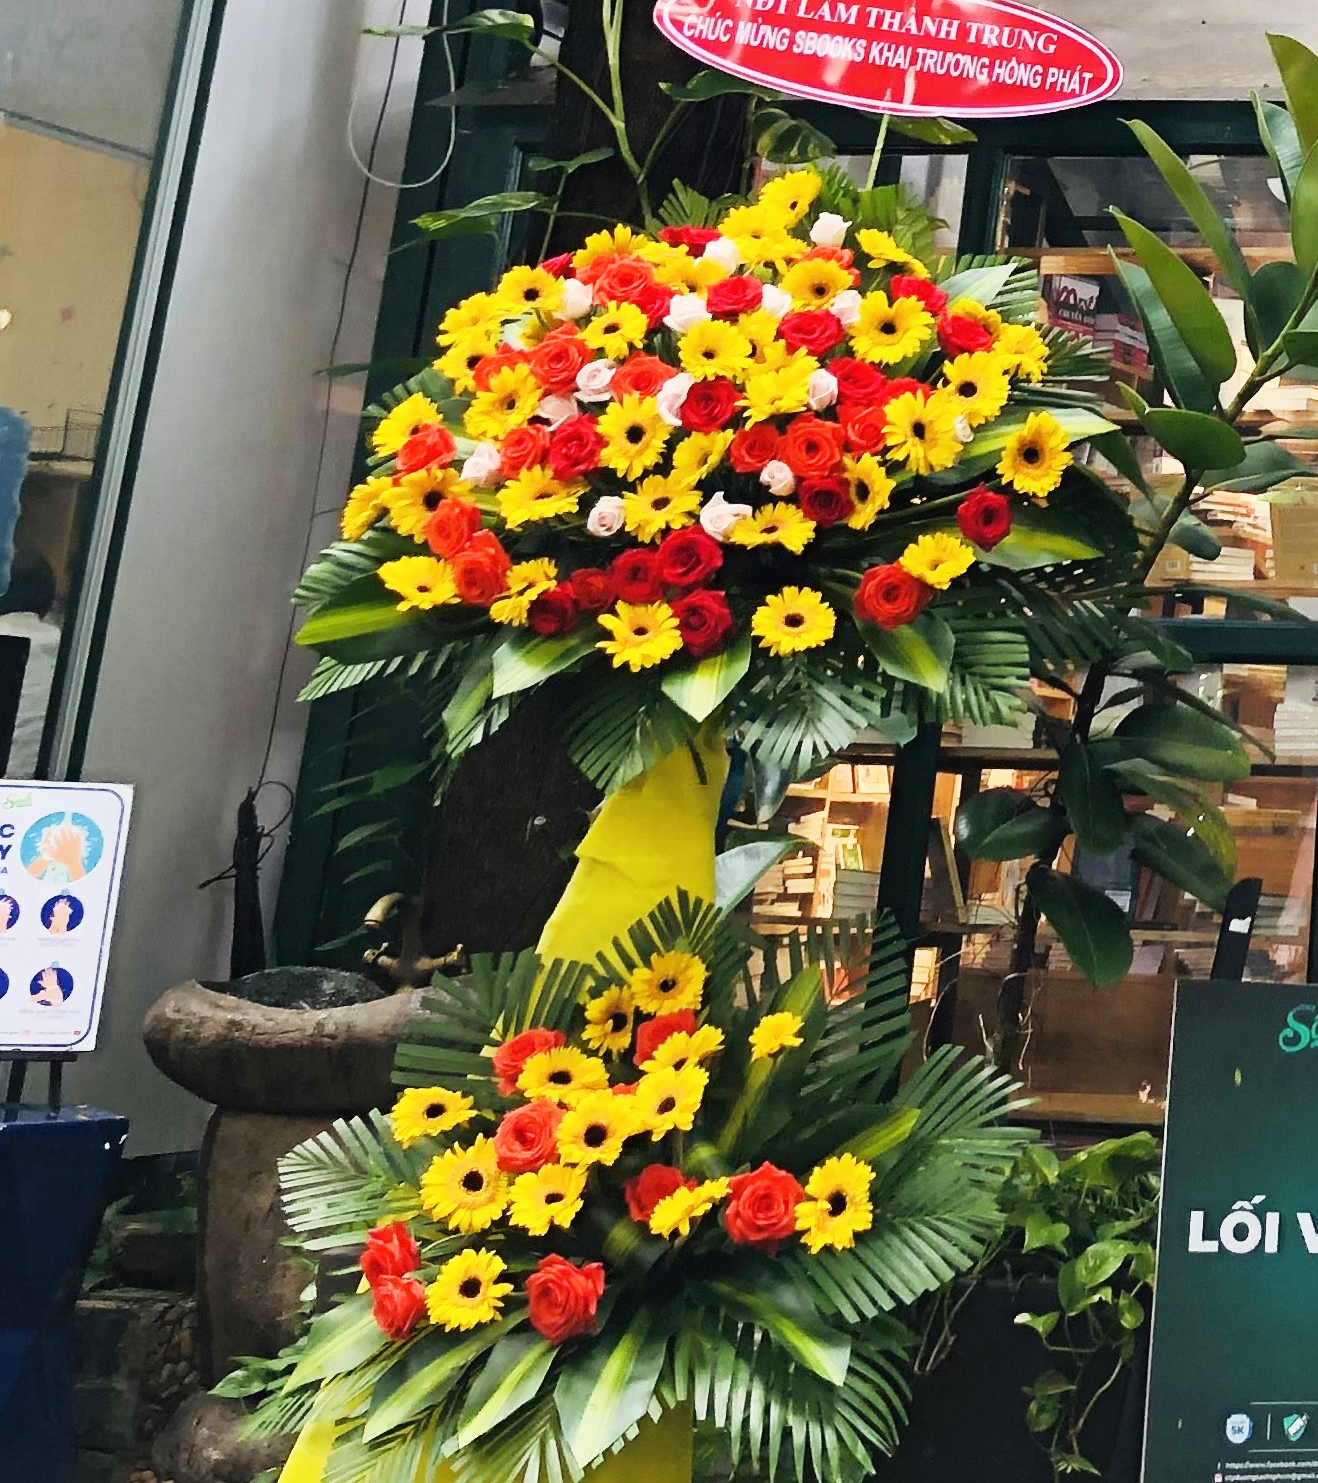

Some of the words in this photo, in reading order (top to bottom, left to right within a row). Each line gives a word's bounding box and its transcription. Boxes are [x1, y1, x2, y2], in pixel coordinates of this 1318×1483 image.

[682, 13, 734, 43] CHÚC
[735, 19, 790, 51] MỪNG
[792, 32, 865, 61] SBOOKS
[868, 43, 912, 69] KHAI
[915, 49, 989, 81] TRƯƠNG
[1045, 66, 1093, 96] PHÁT
[866, 6, 958, 41] THÀNH
[965, 21, 1058, 55] TRUNG
[1187, 1194, 1280, 1254] LỐI
